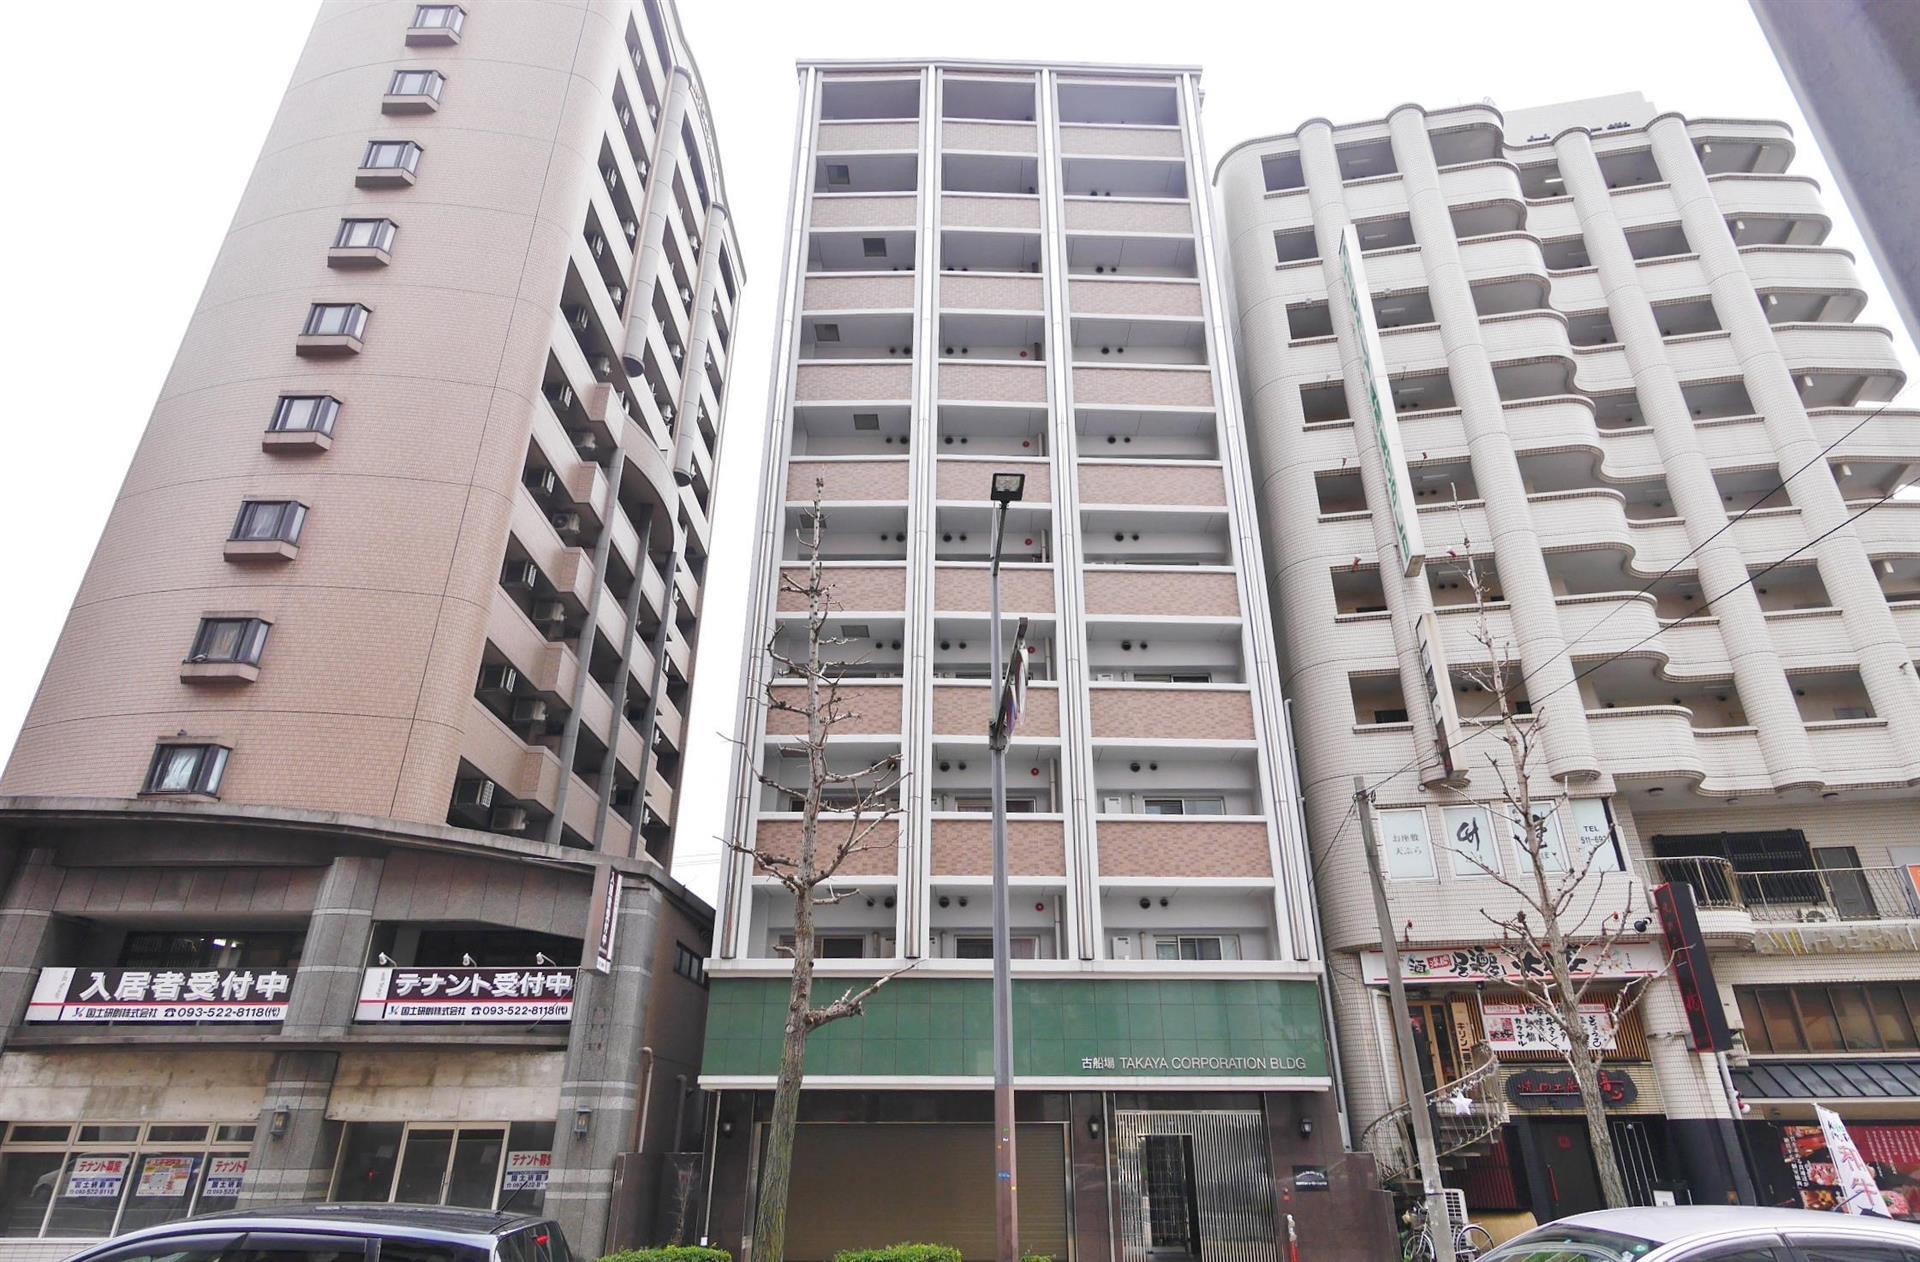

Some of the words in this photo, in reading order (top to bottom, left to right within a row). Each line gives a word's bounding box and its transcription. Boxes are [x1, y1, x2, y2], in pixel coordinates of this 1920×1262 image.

[79, 971, 290, 1002] 入居者受付中
[396, 972, 573, 997] テナント受付中
[1081, 1057, 1115, 1069] 古船場
[1120, 1057, 1169, 1069] TAKAYA
[1171, 1057, 1266, 1069] CORPORATION
[1270, 1057, 1307, 1069] BLDG
